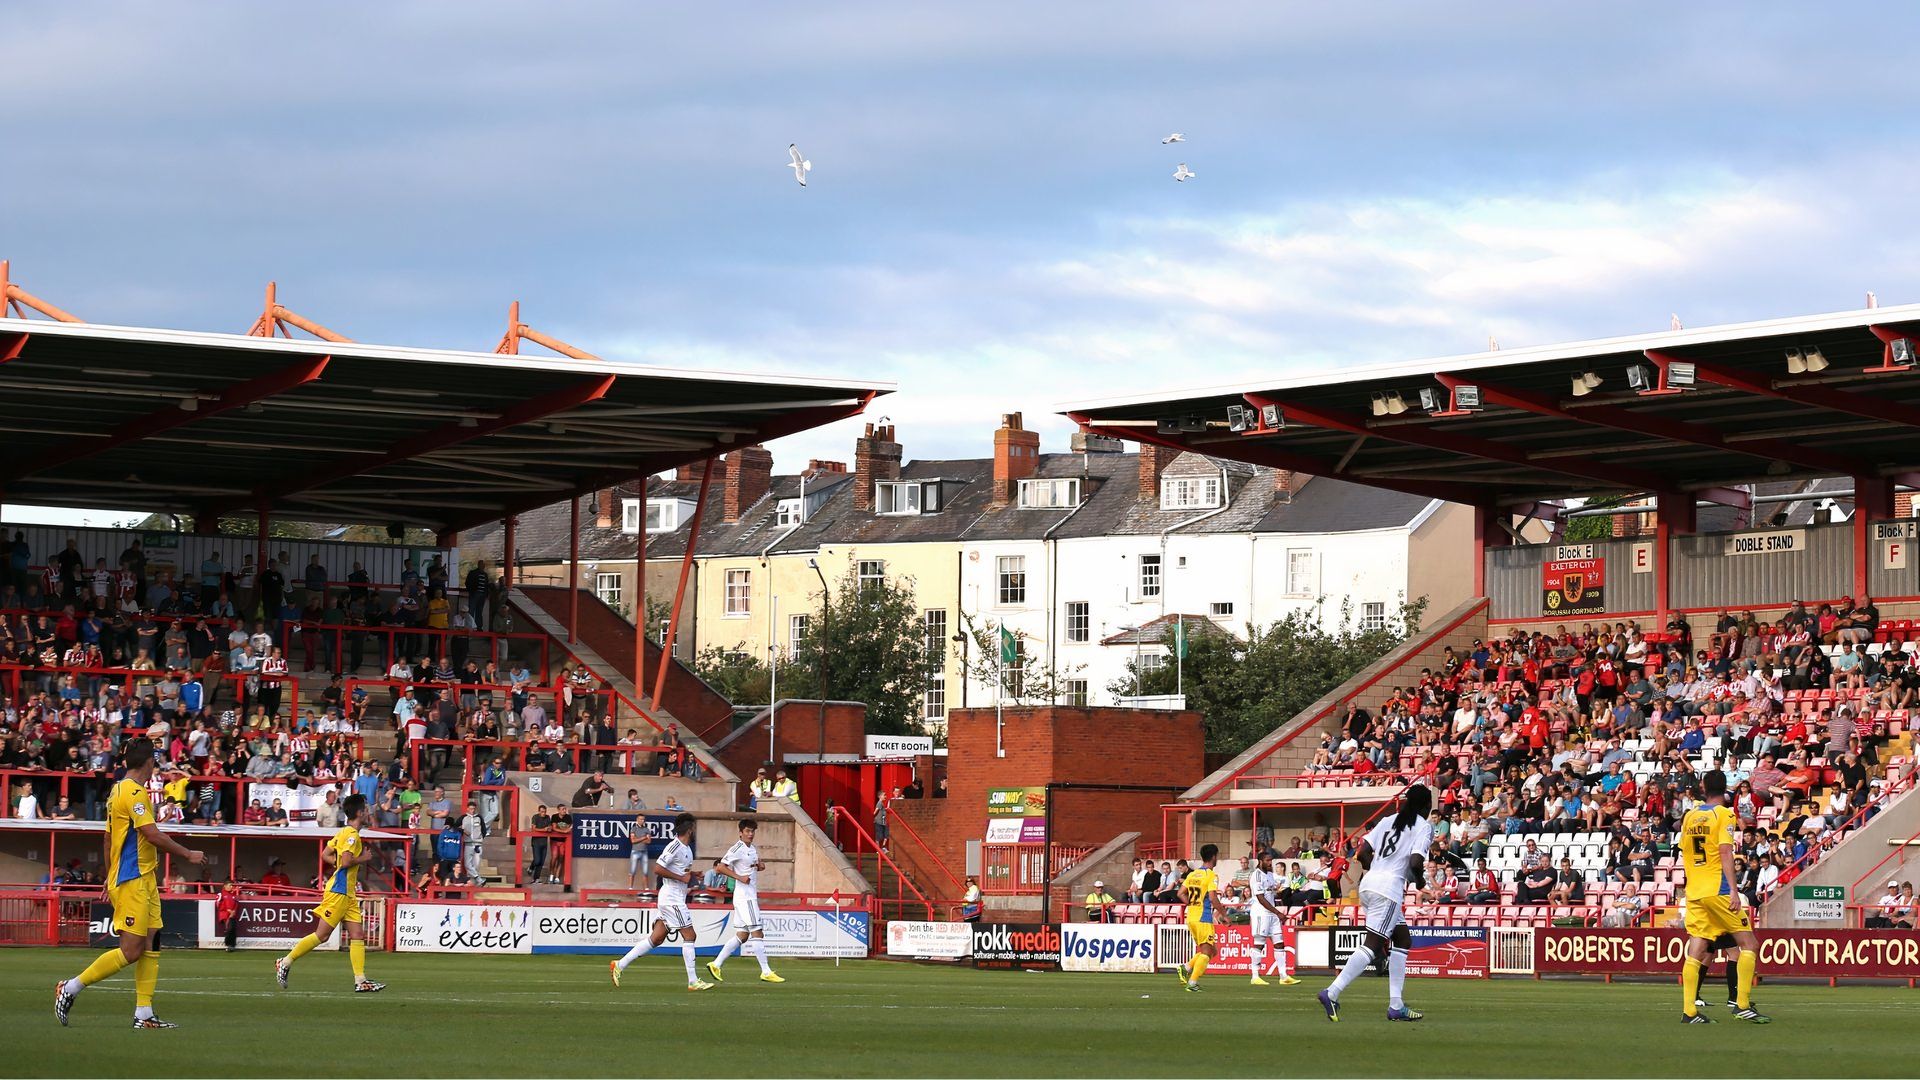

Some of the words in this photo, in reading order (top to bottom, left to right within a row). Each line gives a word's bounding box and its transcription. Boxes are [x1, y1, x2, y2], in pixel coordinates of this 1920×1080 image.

[1878, 525, 1903, 538] Block
[1907, 523, 1914, 537] F
[1735, 538, 1764, 552] DOBLE
[1766, 535, 1794, 550] STAND
[1559, 546, 1581, 559] Block
[1585, 545, 1592, 557] E
[1637, 549, 1646, 567] E
[1890, 544, 1899, 563] F
[1551, 562, 1579, 571] EXETER
[1579, 560, 1596, 569] CITY
[874, 742, 900, 750] TICKET
[901, 743, 929, 751] BOOTH
[989, 791, 1023, 804] SUBWAY
[1379, 828, 1401, 859] 18
[1691, 836, 1707, 866] 5
[1813, 888, 1827, 897] Exit
[399, 910, 416, 920] It's
[1797, 909, 1822, 918] Catering
[399, 924, 423, 936] easy
[539, 913, 608, 934] exeter
[760, 918, 813, 933] ENROSE
[842, 913, 867, 933] 10%
[908, 923, 922, 932] Join
[922, 923, 934, 932] the
[935, 924, 948, 932] RED
[950, 924, 970, 933] ARMY
[439, 930, 528, 949] exeter
[974, 923, 1060, 951] rokkmedia
[1220, 933, 1226, 943] a
[1228, 929, 1242, 943] life
[1338, 934, 1358, 948] JMT
[1409, 929, 1423, 937] EVON
[1423, 929, 1433, 937] AIR
[1433, 930, 1465, 938] AMBULANCE
[1466, 930, 1483, 938] TRUST
[1063, 931, 1152, 964] Vospers
[1220, 943, 1239, 960] give
[1545, 935, 1635, 963] ROBERTS
[1759, 938, 1919, 966] CONTRACTOR
[973, 951, 995, 959] software
[998, 951, 1016, 960] mobile
[1019, 951, 1031, 960] web
[1033, 951, 1060, 963] marketing
